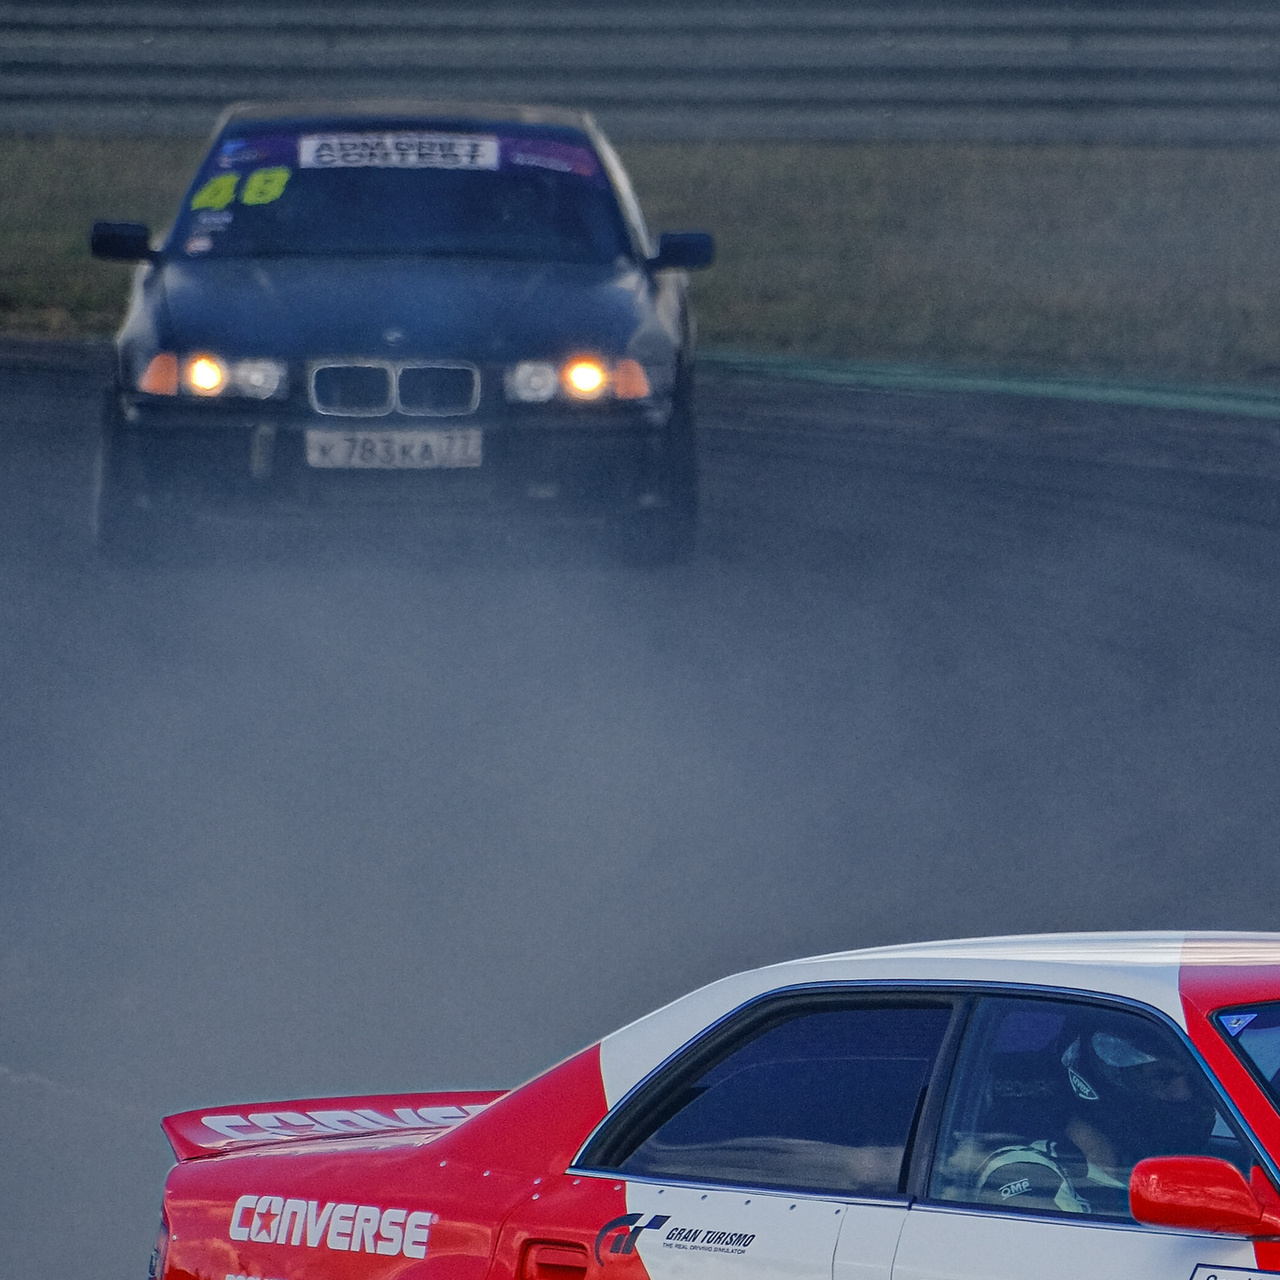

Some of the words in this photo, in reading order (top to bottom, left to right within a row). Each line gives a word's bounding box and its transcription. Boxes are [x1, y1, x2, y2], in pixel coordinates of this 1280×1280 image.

[1001, 1181, 1030, 1197] OMP
[229, 1195, 433, 1259] CONVERSE
[665, 1227, 703, 1243] GRAN
[700, 1230, 756, 1248] TURISMO
[674, 1243, 688, 1251] REAL
